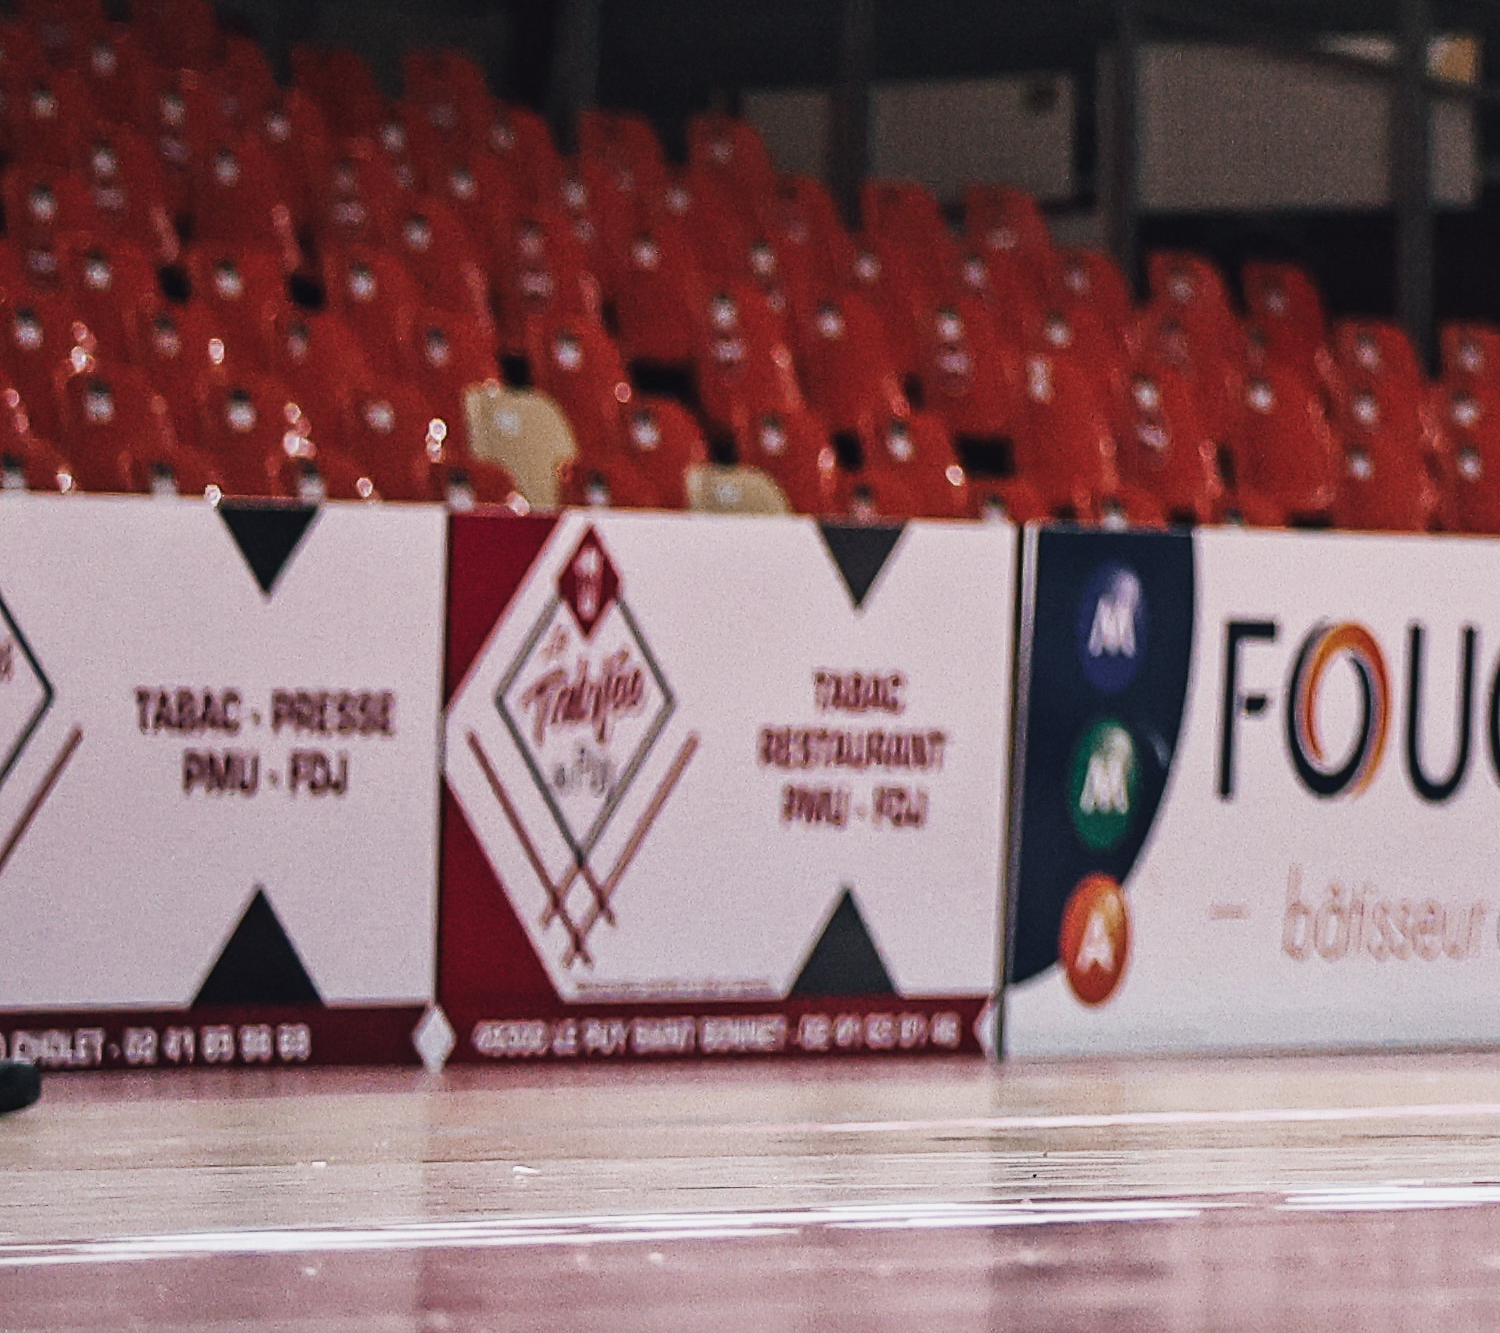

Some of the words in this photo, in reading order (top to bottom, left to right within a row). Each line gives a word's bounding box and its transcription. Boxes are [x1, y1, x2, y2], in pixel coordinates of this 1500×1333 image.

[134, 687, 242, 734] TABAC
[270, 687, 395, 738] PRESSE
[813, 670, 905, 714] TABAC
[183, 747, 259, 797] PMU
[290, 749, 348, 797] FDJ
[757, 726, 945, 770] RESTAURANT
[1281, 861, 1484, 962] bâtisseur
